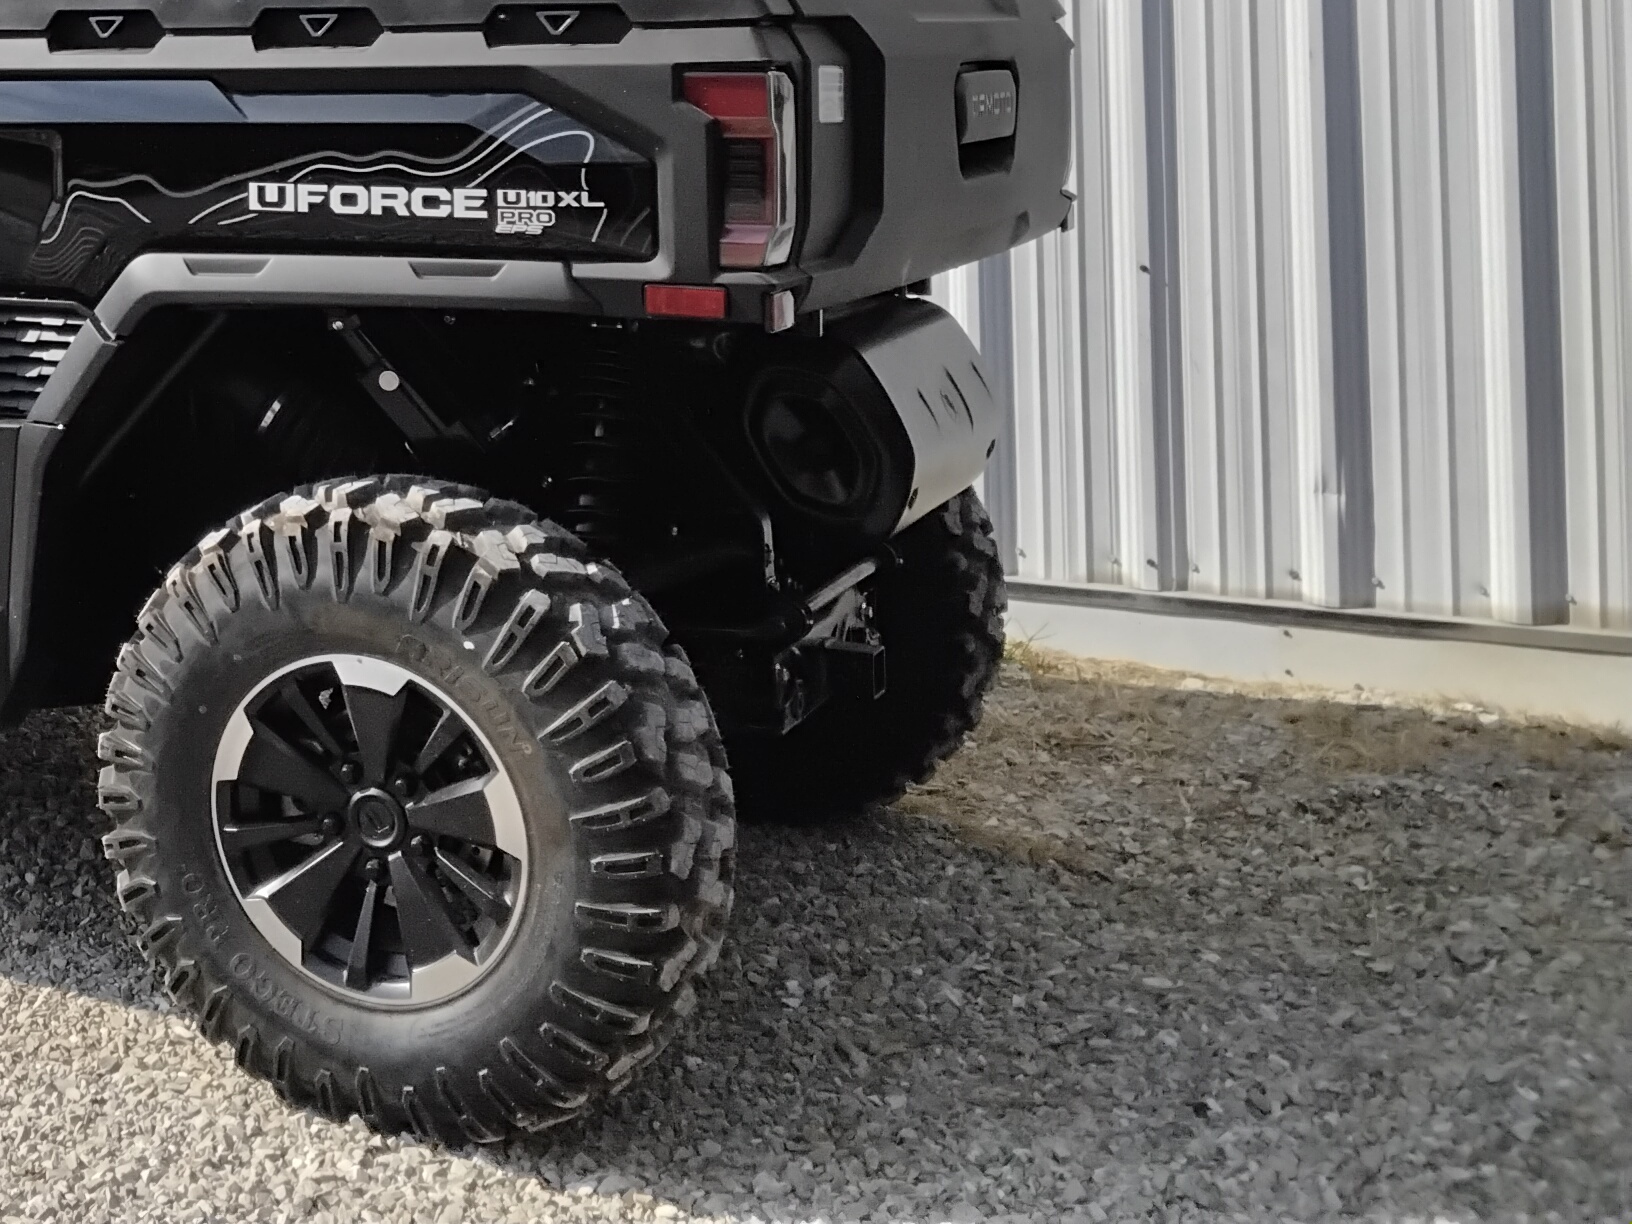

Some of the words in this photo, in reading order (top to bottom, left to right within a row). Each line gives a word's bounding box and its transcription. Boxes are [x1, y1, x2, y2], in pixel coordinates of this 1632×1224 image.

[249, 181, 488, 218] UFORCE
[497, 209, 556, 226] PRO
[495, 225, 544, 235] EPS
